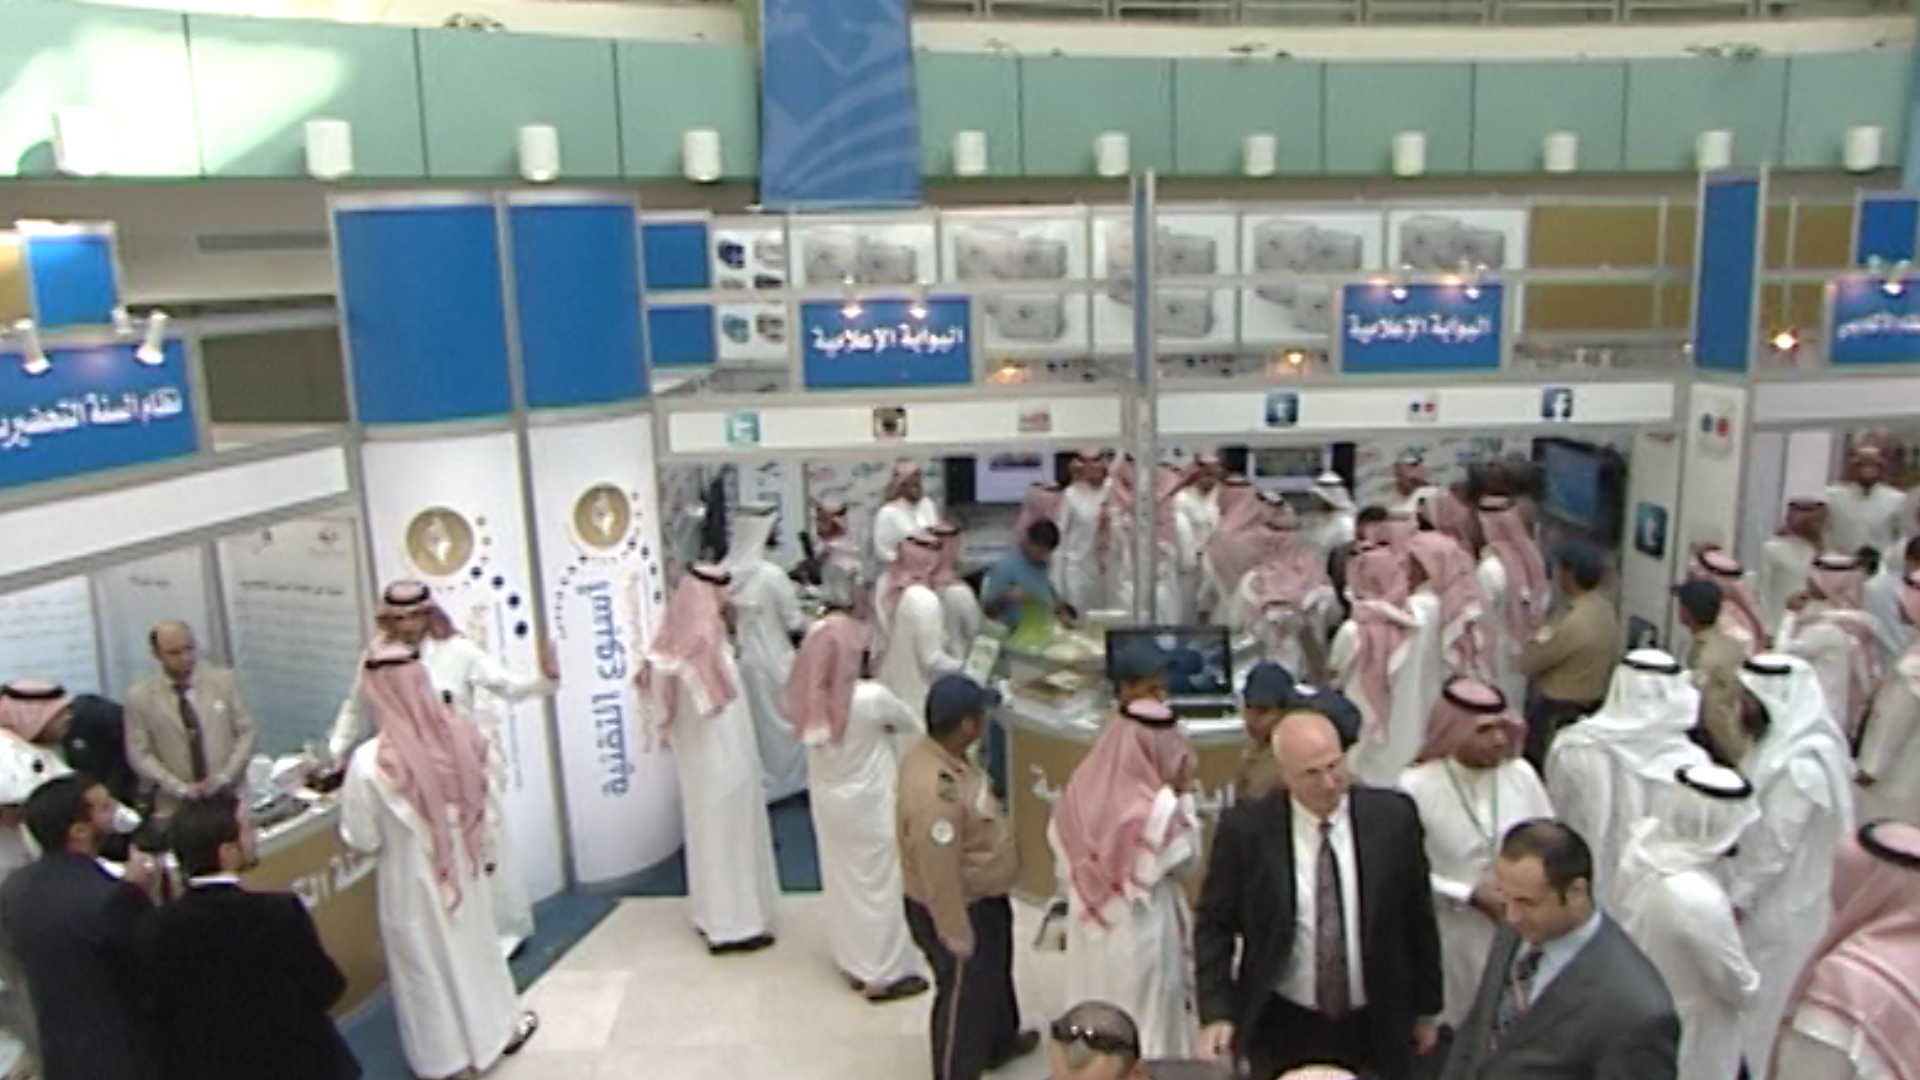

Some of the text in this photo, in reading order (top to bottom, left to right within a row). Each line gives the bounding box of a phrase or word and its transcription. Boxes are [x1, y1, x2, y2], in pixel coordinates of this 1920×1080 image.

[899, 323, 964, 353] البوابة
[575, 579, 626, 682] أسبوع
[592, 690, 636, 797] التقنية
